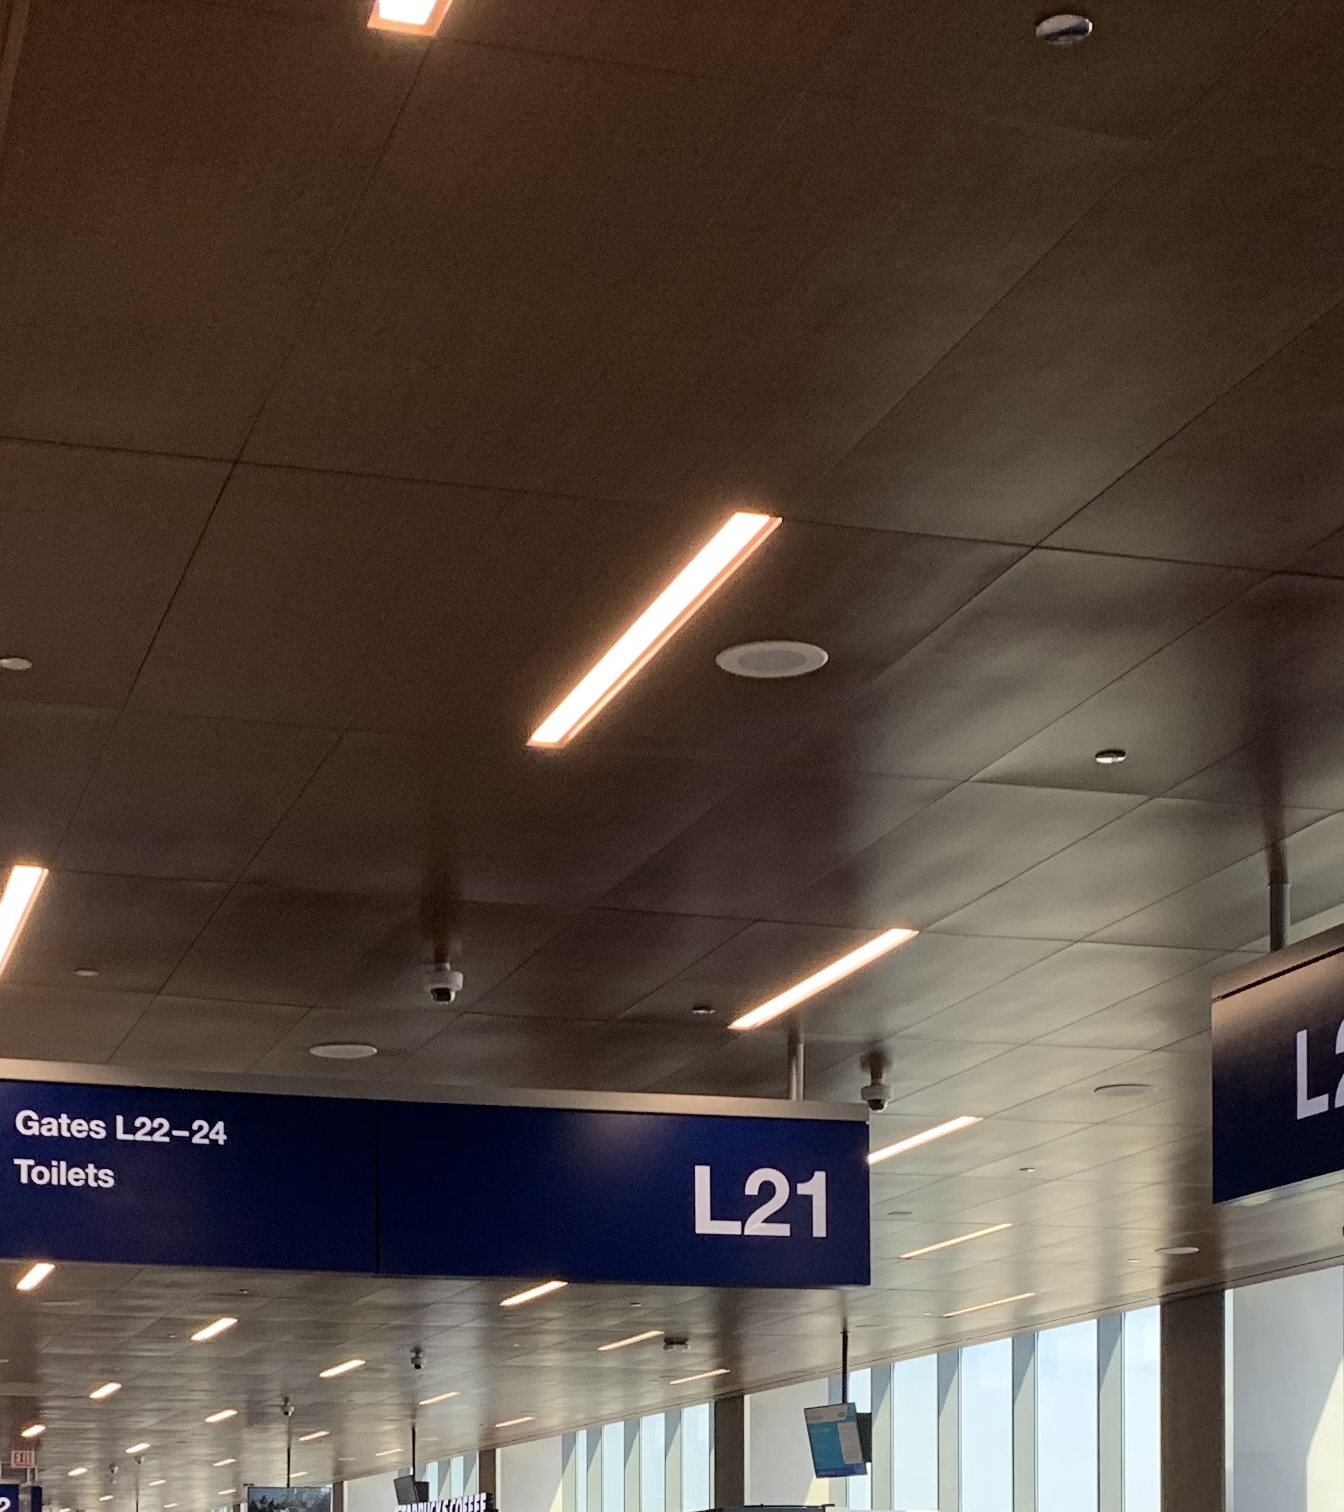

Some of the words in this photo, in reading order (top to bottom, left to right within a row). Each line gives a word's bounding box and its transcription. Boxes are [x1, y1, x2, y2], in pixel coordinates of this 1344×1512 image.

[15, 1109, 106, 1140] Gates
[13, 1158, 115, 1188] Toilets
[694, 1164, 827, 1238] L21
[14, 1452, 32, 1466] EXIT
